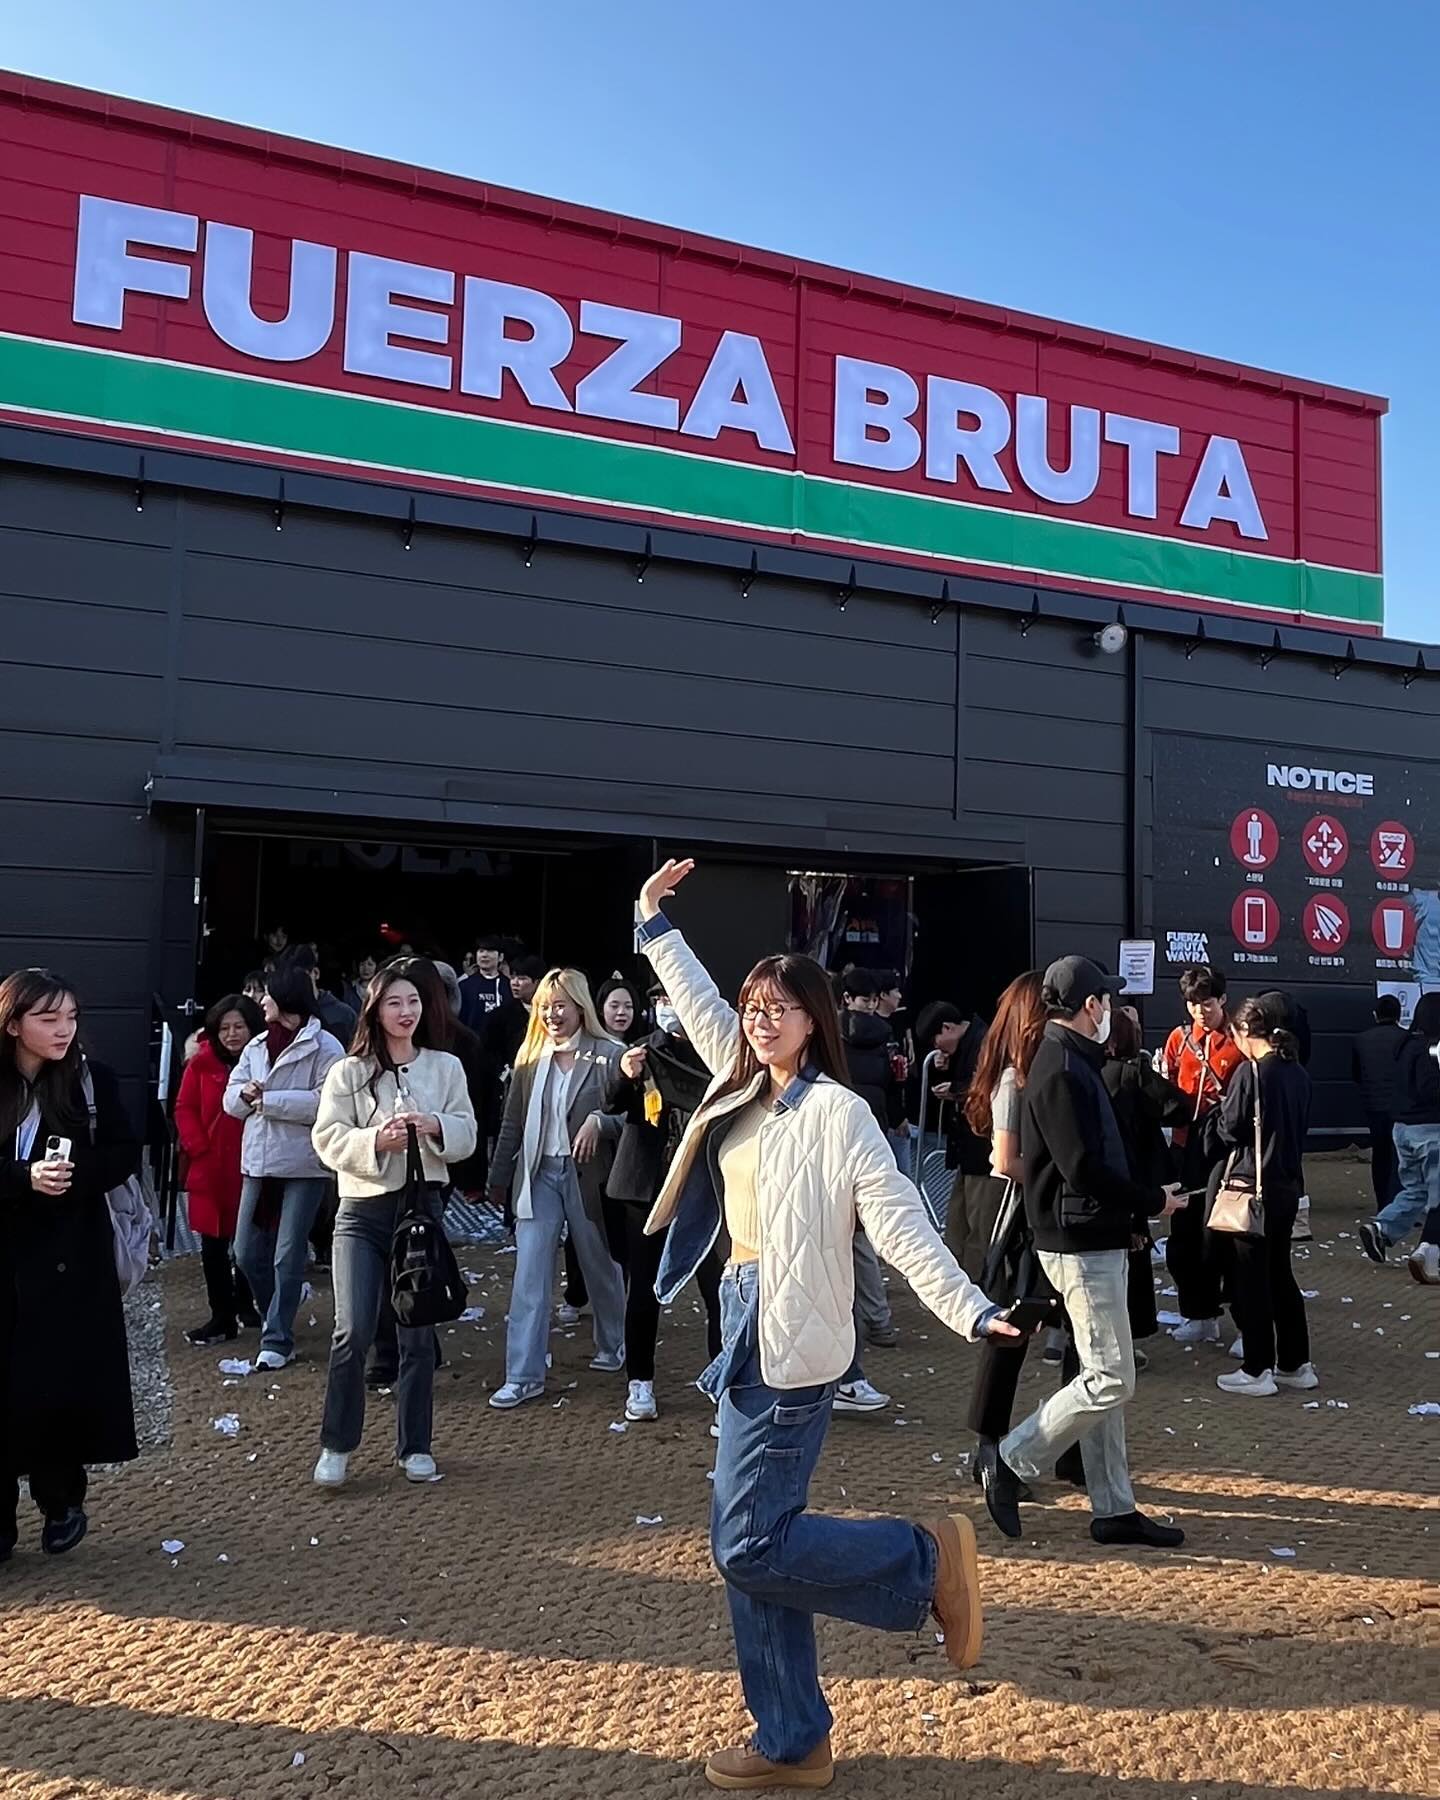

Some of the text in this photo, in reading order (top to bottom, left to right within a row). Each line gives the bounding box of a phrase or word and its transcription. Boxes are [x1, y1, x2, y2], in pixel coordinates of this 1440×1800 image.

[72, 194, 1269, 541] FUERZA BRUTA
[1267, 764, 1375, 796] NOTICE
[1166, 931, 1209, 944] FUERZA
[1170, 941, 1205, 952] BRUTA
[1165, 950, 1210, 963] WAYRA
